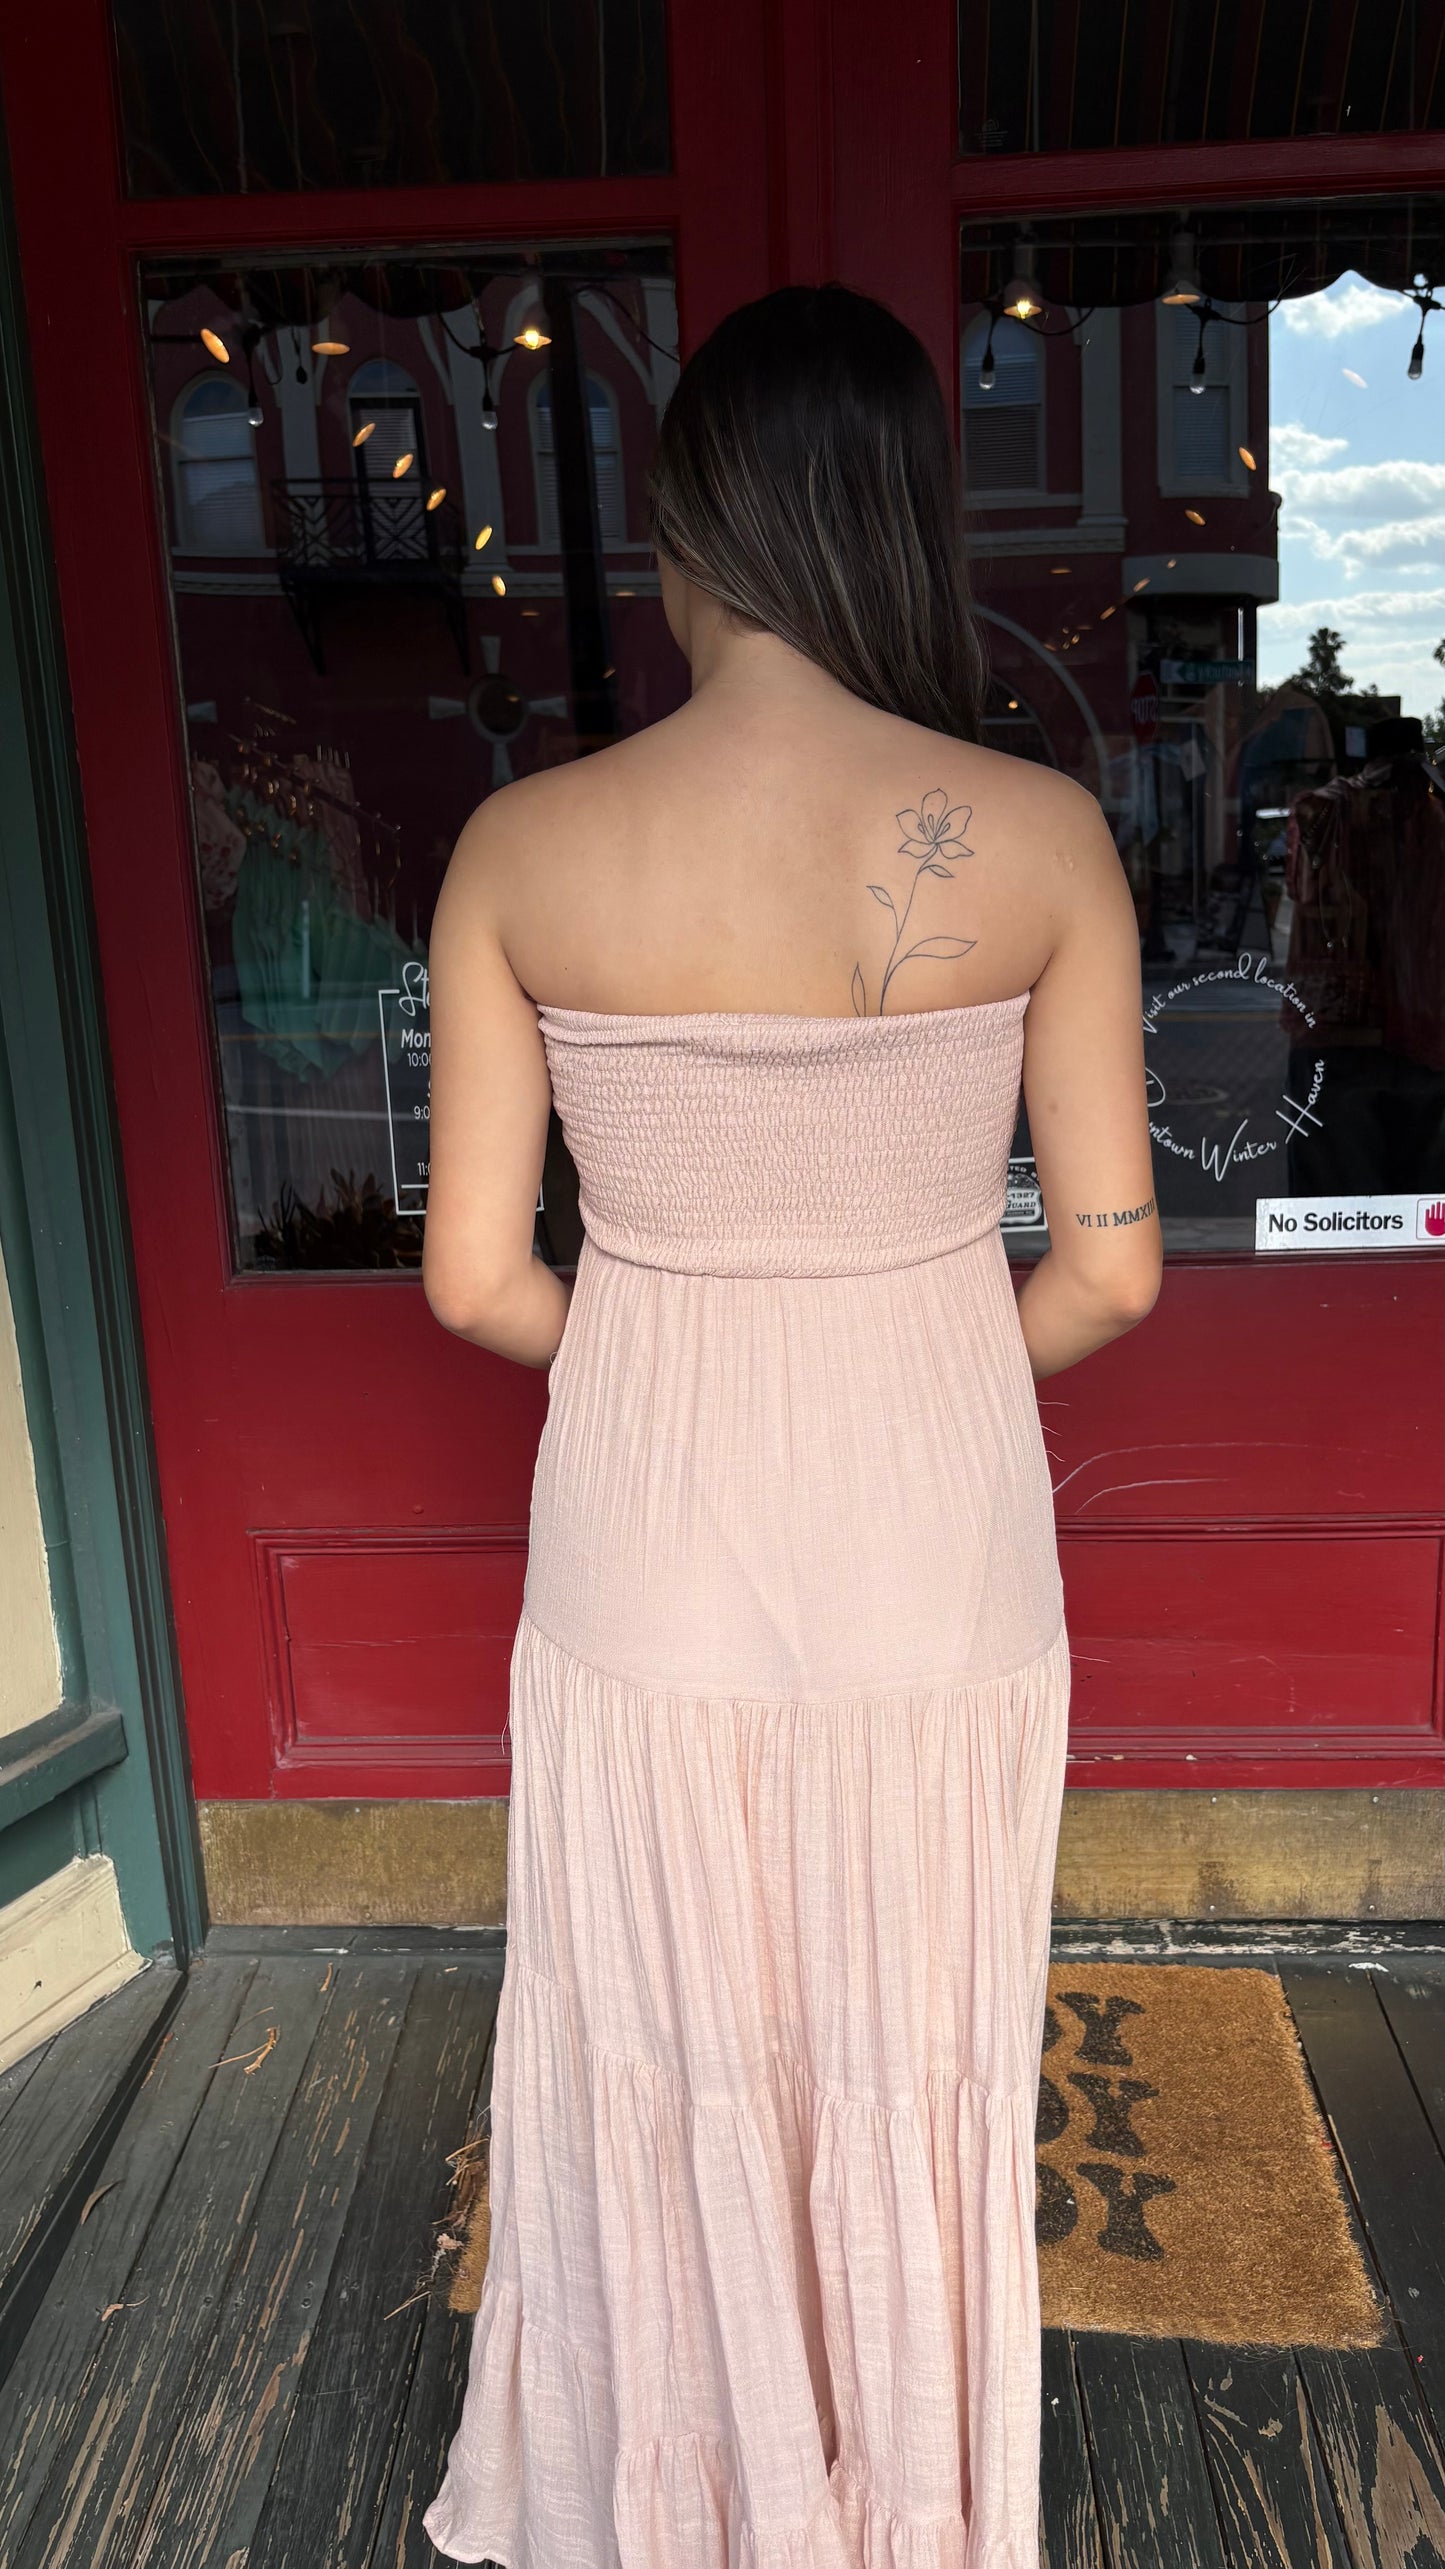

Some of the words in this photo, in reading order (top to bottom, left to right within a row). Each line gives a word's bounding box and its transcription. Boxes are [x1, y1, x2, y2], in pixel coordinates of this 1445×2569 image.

[1142, 994, 1166, 1034] Visit
[1168, 982, 1191, 1000] our
[1192, 952, 1251, 986] second
[1254, 957, 1306, 1013] location
[1304, 1011, 1316, 1029] in
[407, 1052, 431, 1067] 10:0
[1201, 1118, 1277, 1182] Winter
[1275, 1058, 1325, 1145] Haven
[1075, 1213, 1093, 1228] VI
[1096, 1213, 1108, 1228] II
[1268, 1213, 1298, 1233] No
[1303, 1210, 1404, 1232] Solicitors
